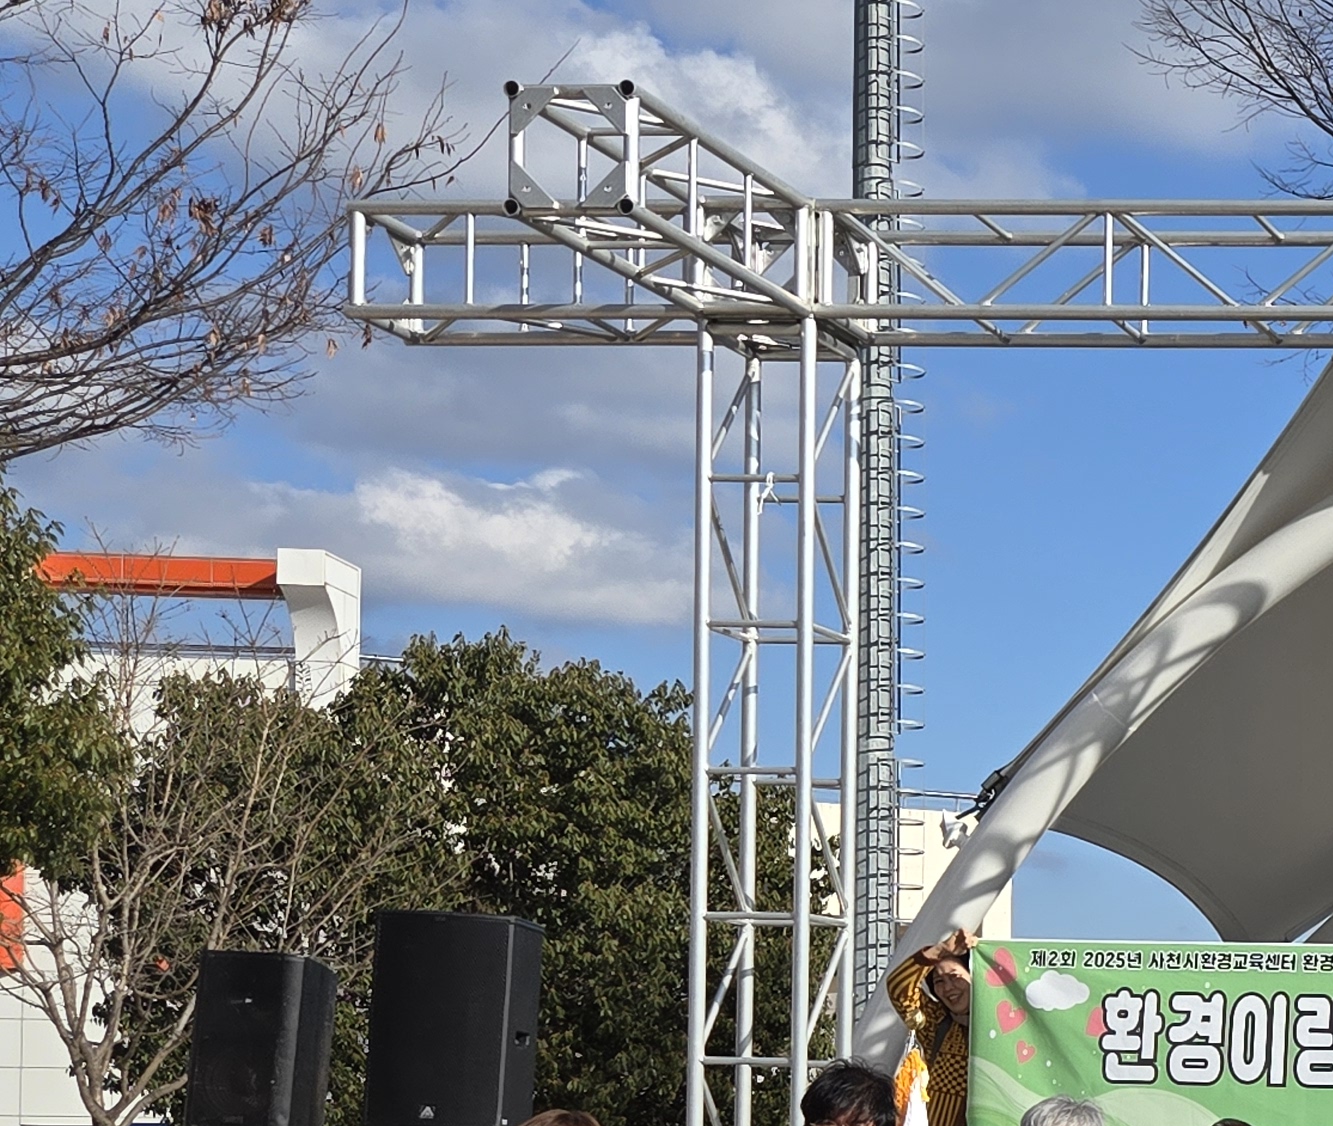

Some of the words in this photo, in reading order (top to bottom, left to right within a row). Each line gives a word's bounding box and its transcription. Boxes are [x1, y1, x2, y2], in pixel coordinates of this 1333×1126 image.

[1030, 950, 1075, 967] 제2회
[1084, 951, 1142, 969] 2025년
[1150, 953, 1296, 971] 사천시환경교육센터
